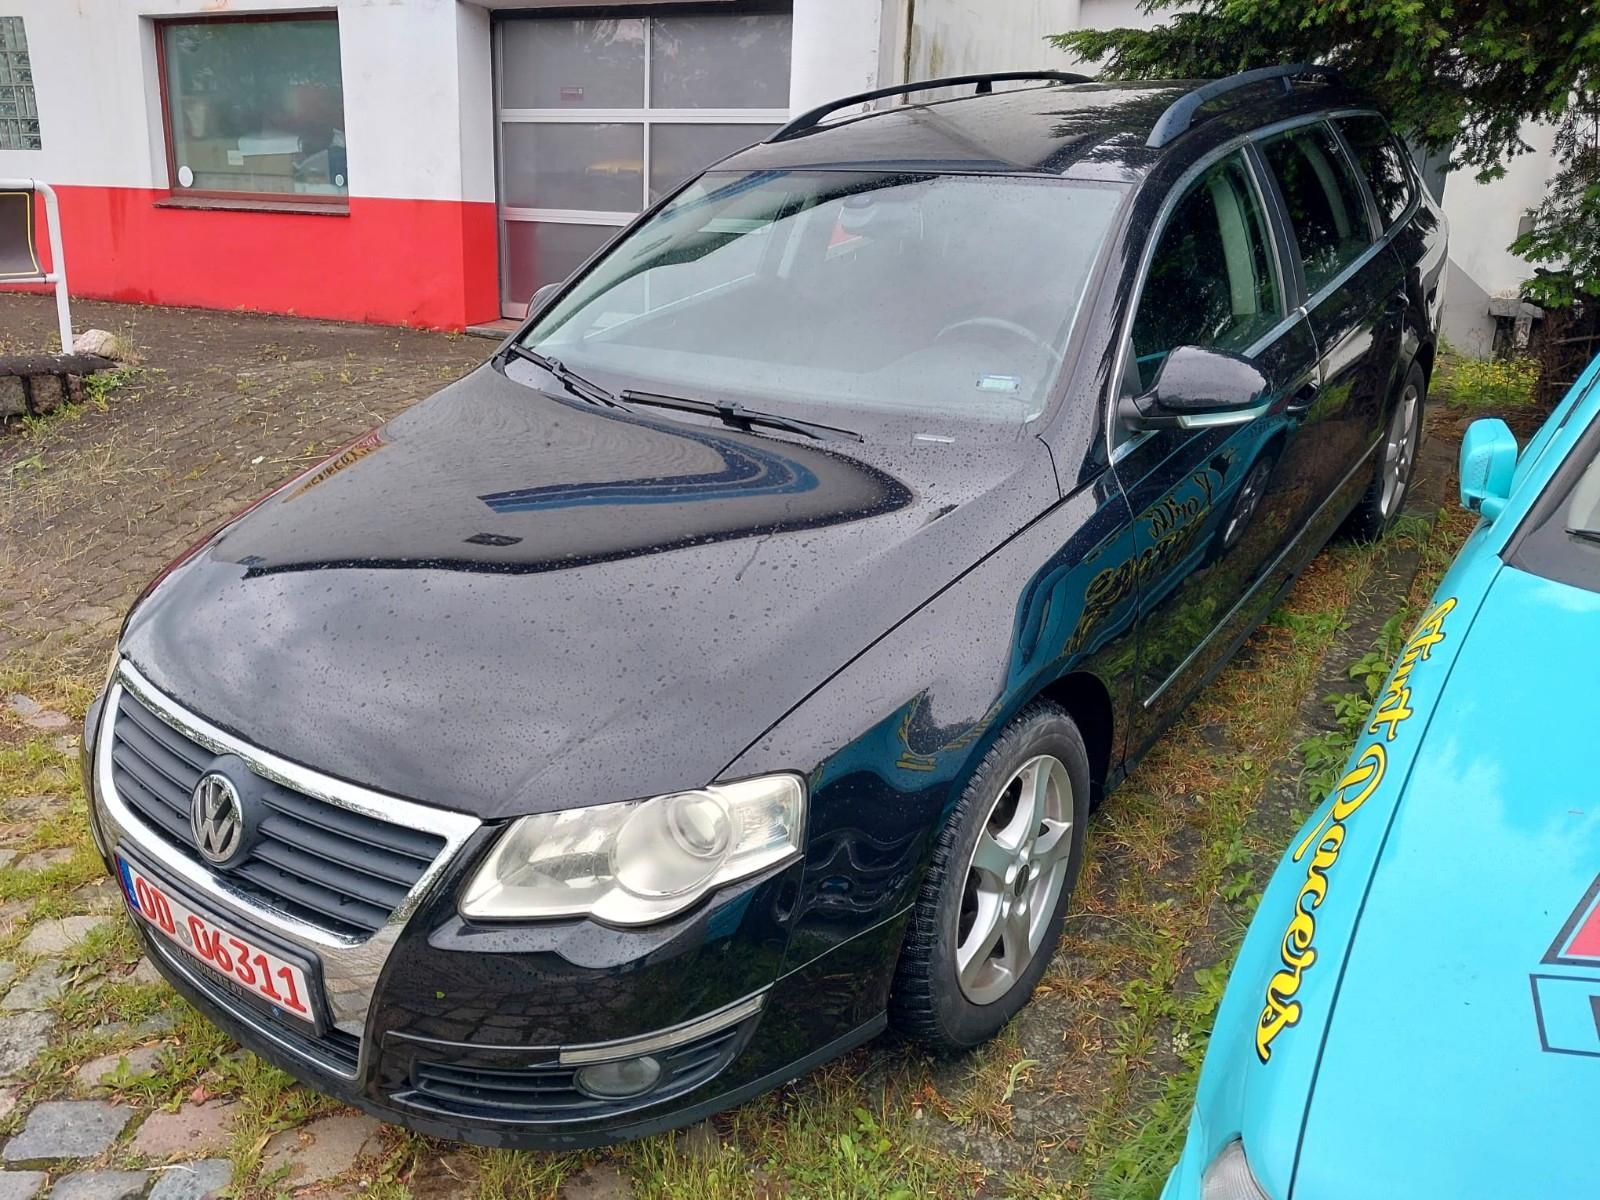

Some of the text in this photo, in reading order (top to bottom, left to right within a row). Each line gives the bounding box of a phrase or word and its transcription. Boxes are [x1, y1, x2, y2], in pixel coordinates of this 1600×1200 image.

[135, 876, 176, 934] OD
[187, 915, 307, 1013] 06311
[1255, 742, 1388, 1064] Racers
